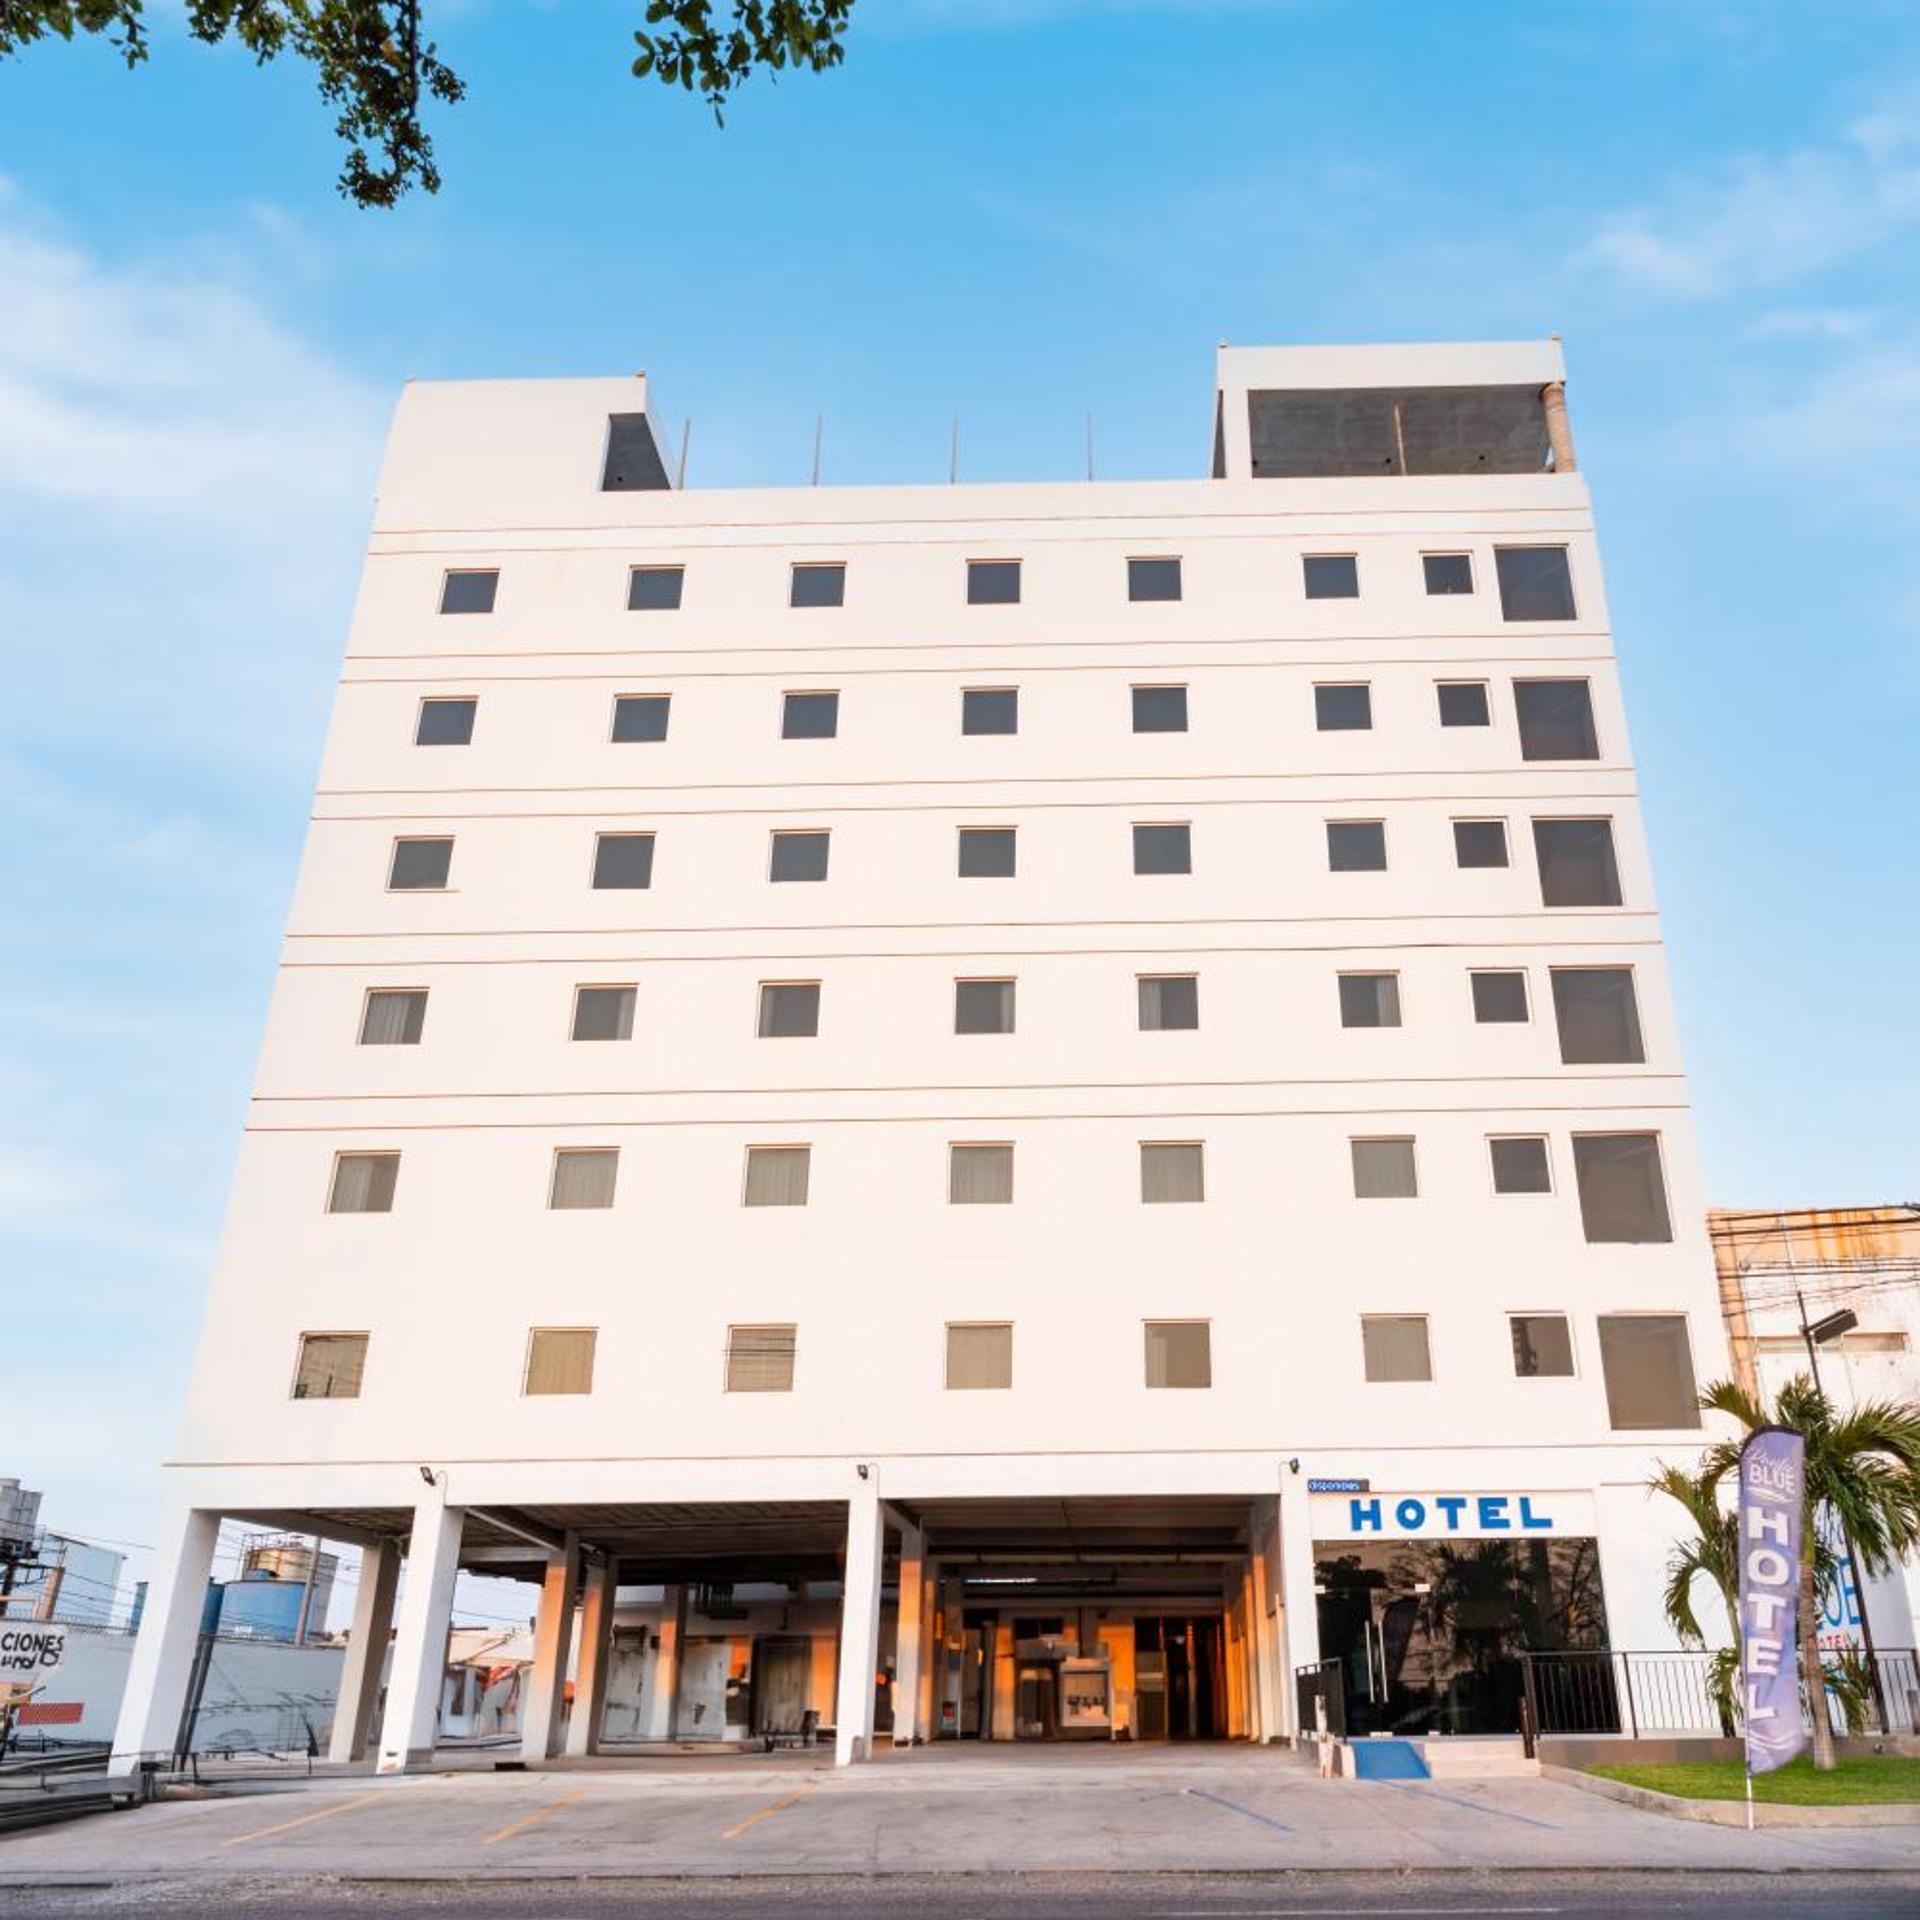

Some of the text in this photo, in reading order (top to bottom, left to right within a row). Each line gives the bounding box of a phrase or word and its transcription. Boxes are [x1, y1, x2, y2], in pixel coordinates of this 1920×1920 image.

[1749, 1464, 1796, 1494] BLUE
[1350, 1497, 1553, 1531] HOTEL
[1748, 1506, 1789, 1720] HOTEL
